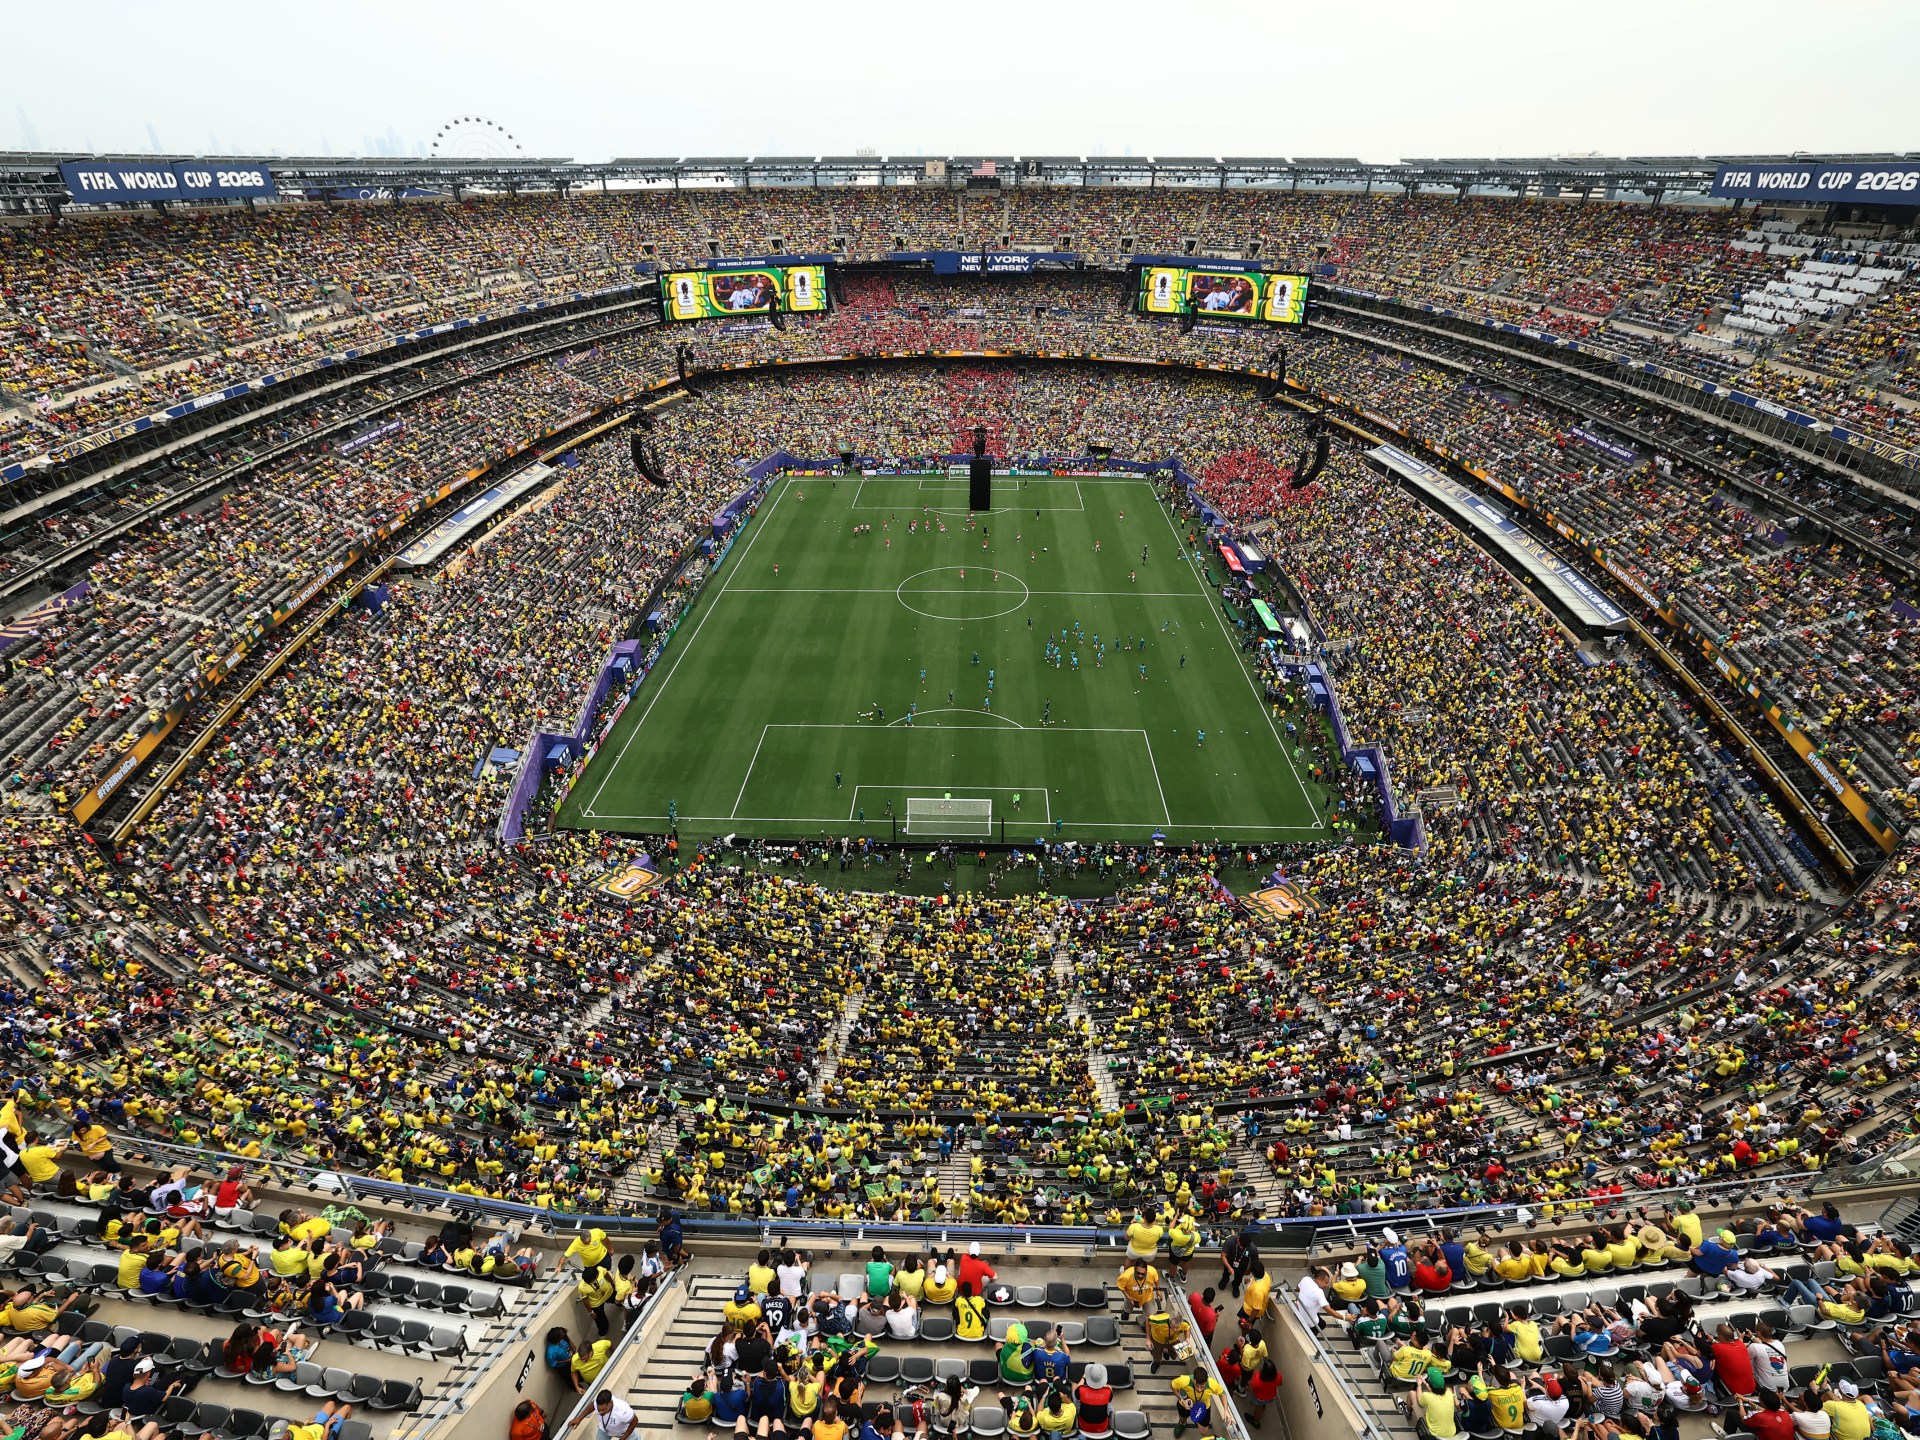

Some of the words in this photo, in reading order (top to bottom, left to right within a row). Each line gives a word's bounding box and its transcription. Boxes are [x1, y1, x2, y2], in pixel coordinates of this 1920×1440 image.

[78, 172, 118, 190] FIFA
[119, 172, 177, 190] WORLD
[184, 172, 212, 188] CUP
[217, 172, 265, 187] 2026
[1721, 172, 1751, 188] FIFA
[1757, 172, 1811, 189] WORLD
[1817, 172, 1852, 190] CUP
[1855, 172, 1920, 191] 2026
[994, 255, 1029, 264] YORK
[341, 441, 355, 452] NEW
[354, 434, 369, 445] YORK
[368, 429, 381, 438] NEW
[1571, 427, 1584, 437] NEW
[1583, 432, 1598, 444] YORK
[1597, 439, 1610, 449] NEW
[1609, 445, 1633, 459] JERSEY
[97, 756, 138, 800] #FIFAWorldCup
[1807, 751, 1845, 796] #FIFAWorldCup
[1394, 1259, 1407, 1277] 10
[765, 1300, 783, 1309] MESSI
[1901, 1294, 1914, 1312] 10
[732, 1317, 746, 1330] 10
[766, 1309, 783, 1327] 19
[964, 1311, 973, 1329] 9
[520, 1357, 532, 1387] 302
[1045, 1367, 1055, 1379] 8
[1408, 1360, 1424, 1377] 10
[1310, 1383, 1320, 1411] 350
[610, 1417, 616, 1425] H
[1507, 1405, 1519, 1422] 9
